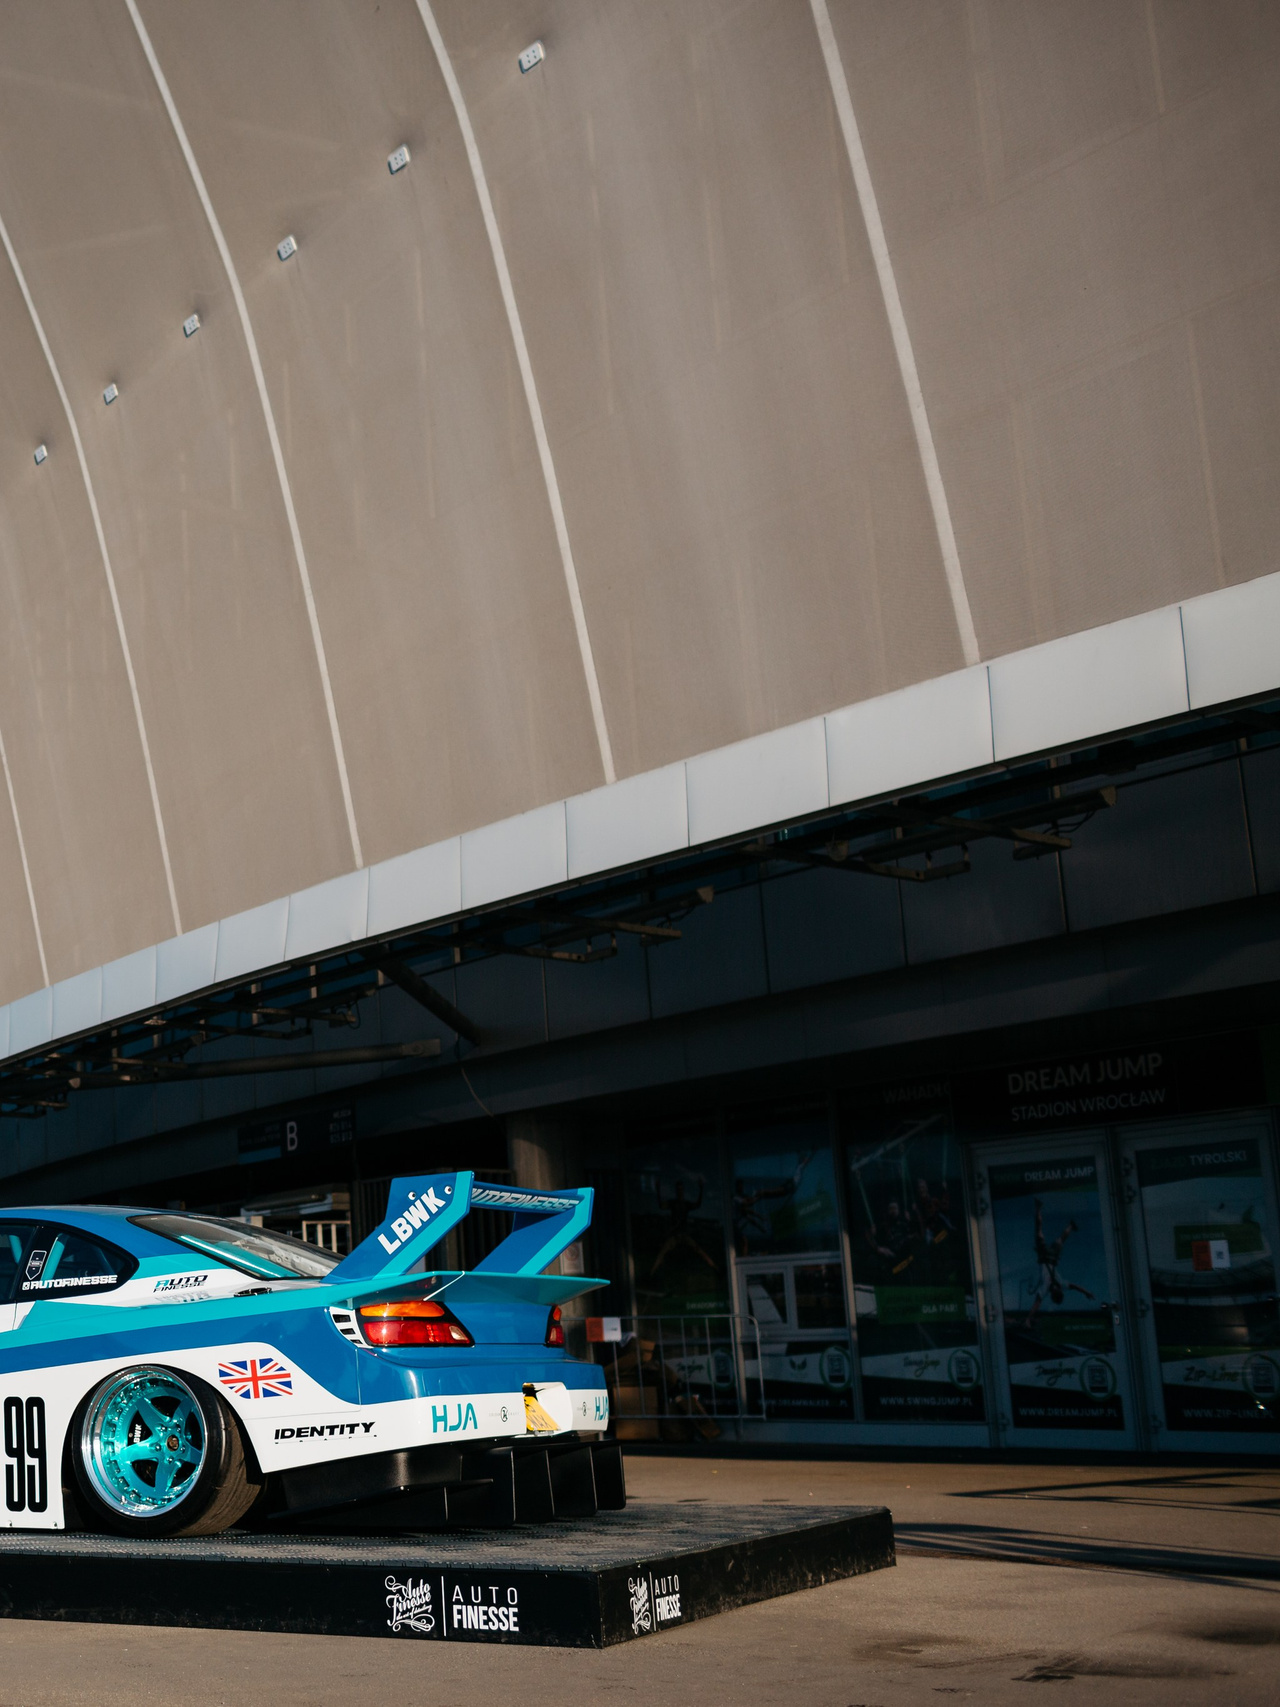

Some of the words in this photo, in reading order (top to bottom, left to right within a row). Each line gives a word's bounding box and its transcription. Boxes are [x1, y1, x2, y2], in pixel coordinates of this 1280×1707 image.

[1008, 1063, 1092, 1095] DREAM
[1097, 1052, 1163, 1083] JUMP
[1011, 1099, 1077, 1122] STADION
[1079, 1088, 1166, 1112] WROCŁAW
[287, 1121, 299, 1152] B
[1189, 1150, 1247, 1166] TYROLSKI
[1024, 1168, 1061, 1183] DREAM
[1063, 1166, 1095, 1179] JUMP
[377, 1186, 446, 1255] LBWK
[153, 1281, 206, 1293] FINESSE
[156, 1275, 208, 1288] AUTO
[432, 1402, 479, 1433] HJA
[1018, 1405, 1119, 1418] WWW.DREAMJUMP.PL
[274, 1421, 376, 1441] IDENTITY
[4, 1396, 48, 1513] 99
[385, 1575, 431, 1600] Auto
[452, 1585, 518, 1605] AUTO
[655, 1575, 680, 1596] AUTO
[386, 1594, 431, 1621] Finesse
[453, 1604, 519, 1632] FINESSE
[656, 1594, 682, 1622] FINESSE
